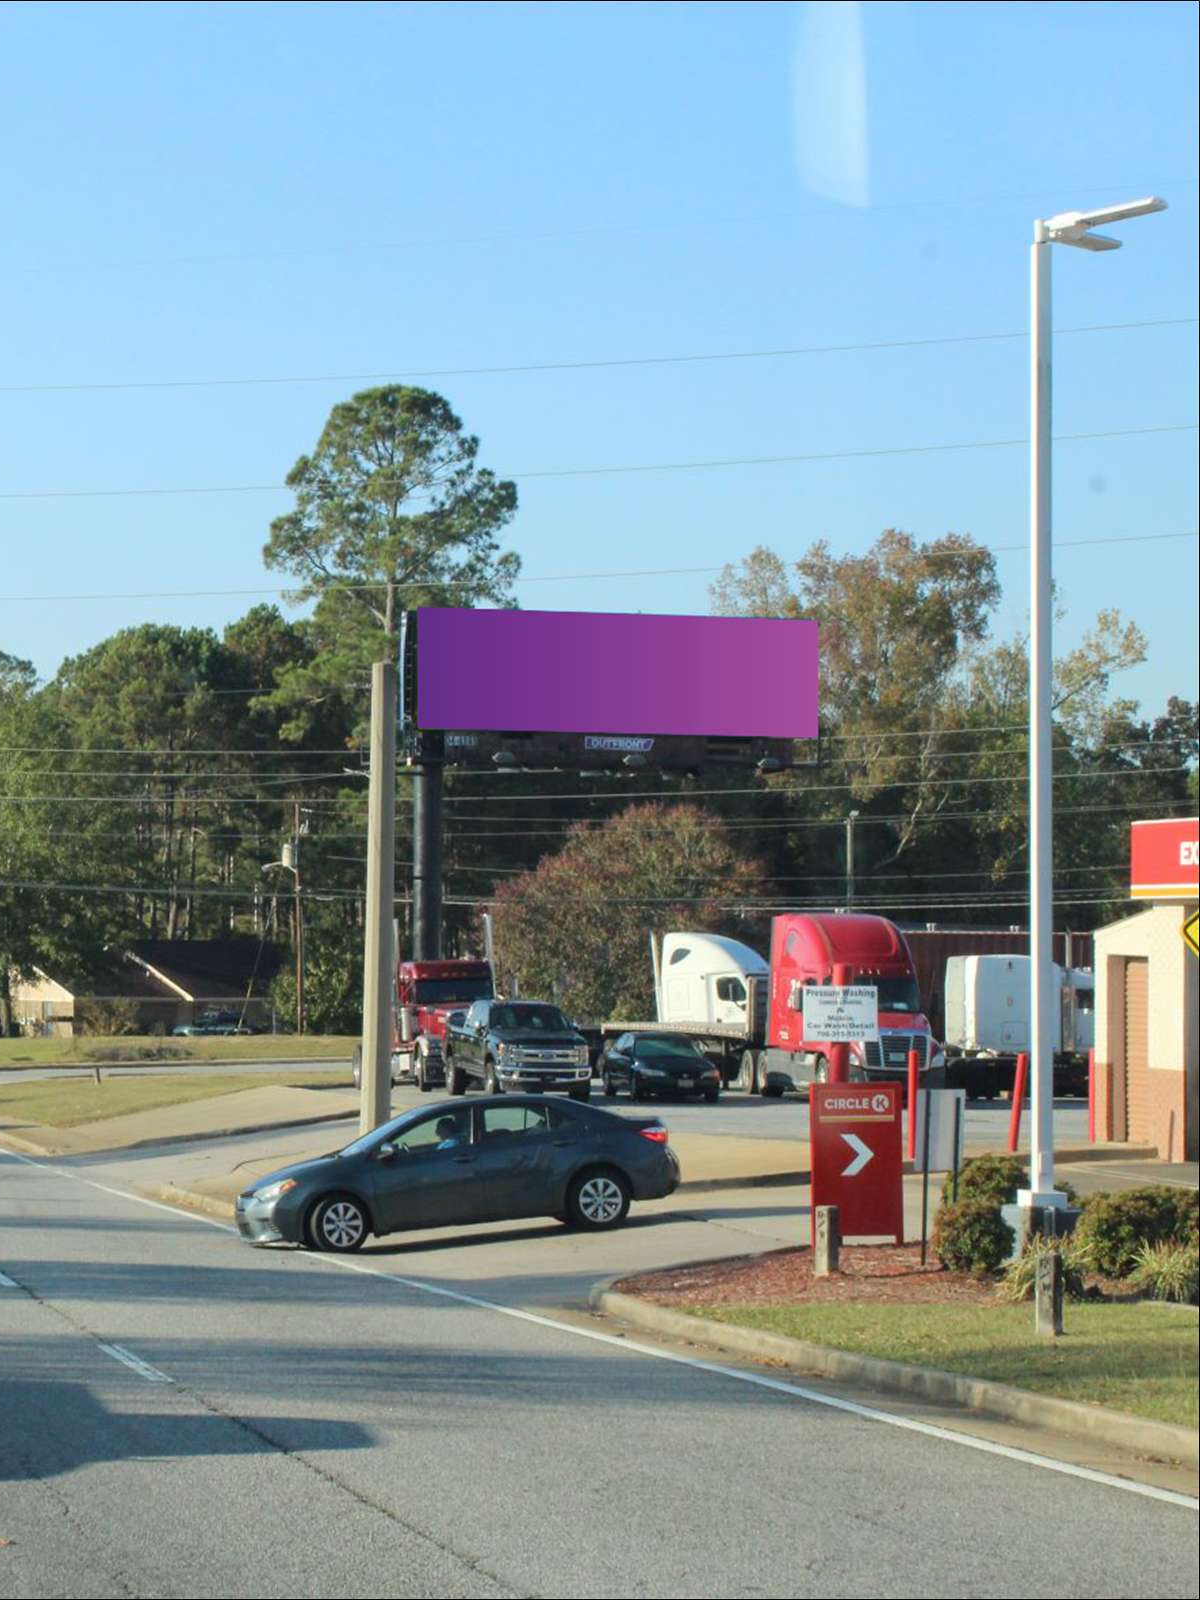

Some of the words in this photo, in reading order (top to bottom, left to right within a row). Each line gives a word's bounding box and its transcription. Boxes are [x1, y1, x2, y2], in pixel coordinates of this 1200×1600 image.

[591, 738, 648, 750] OUTFRONT
[843, 988, 876, 999] Washing
[824, 1098, 869, 1110] CIRCLE
[872, 1094, 889, 1112] K
